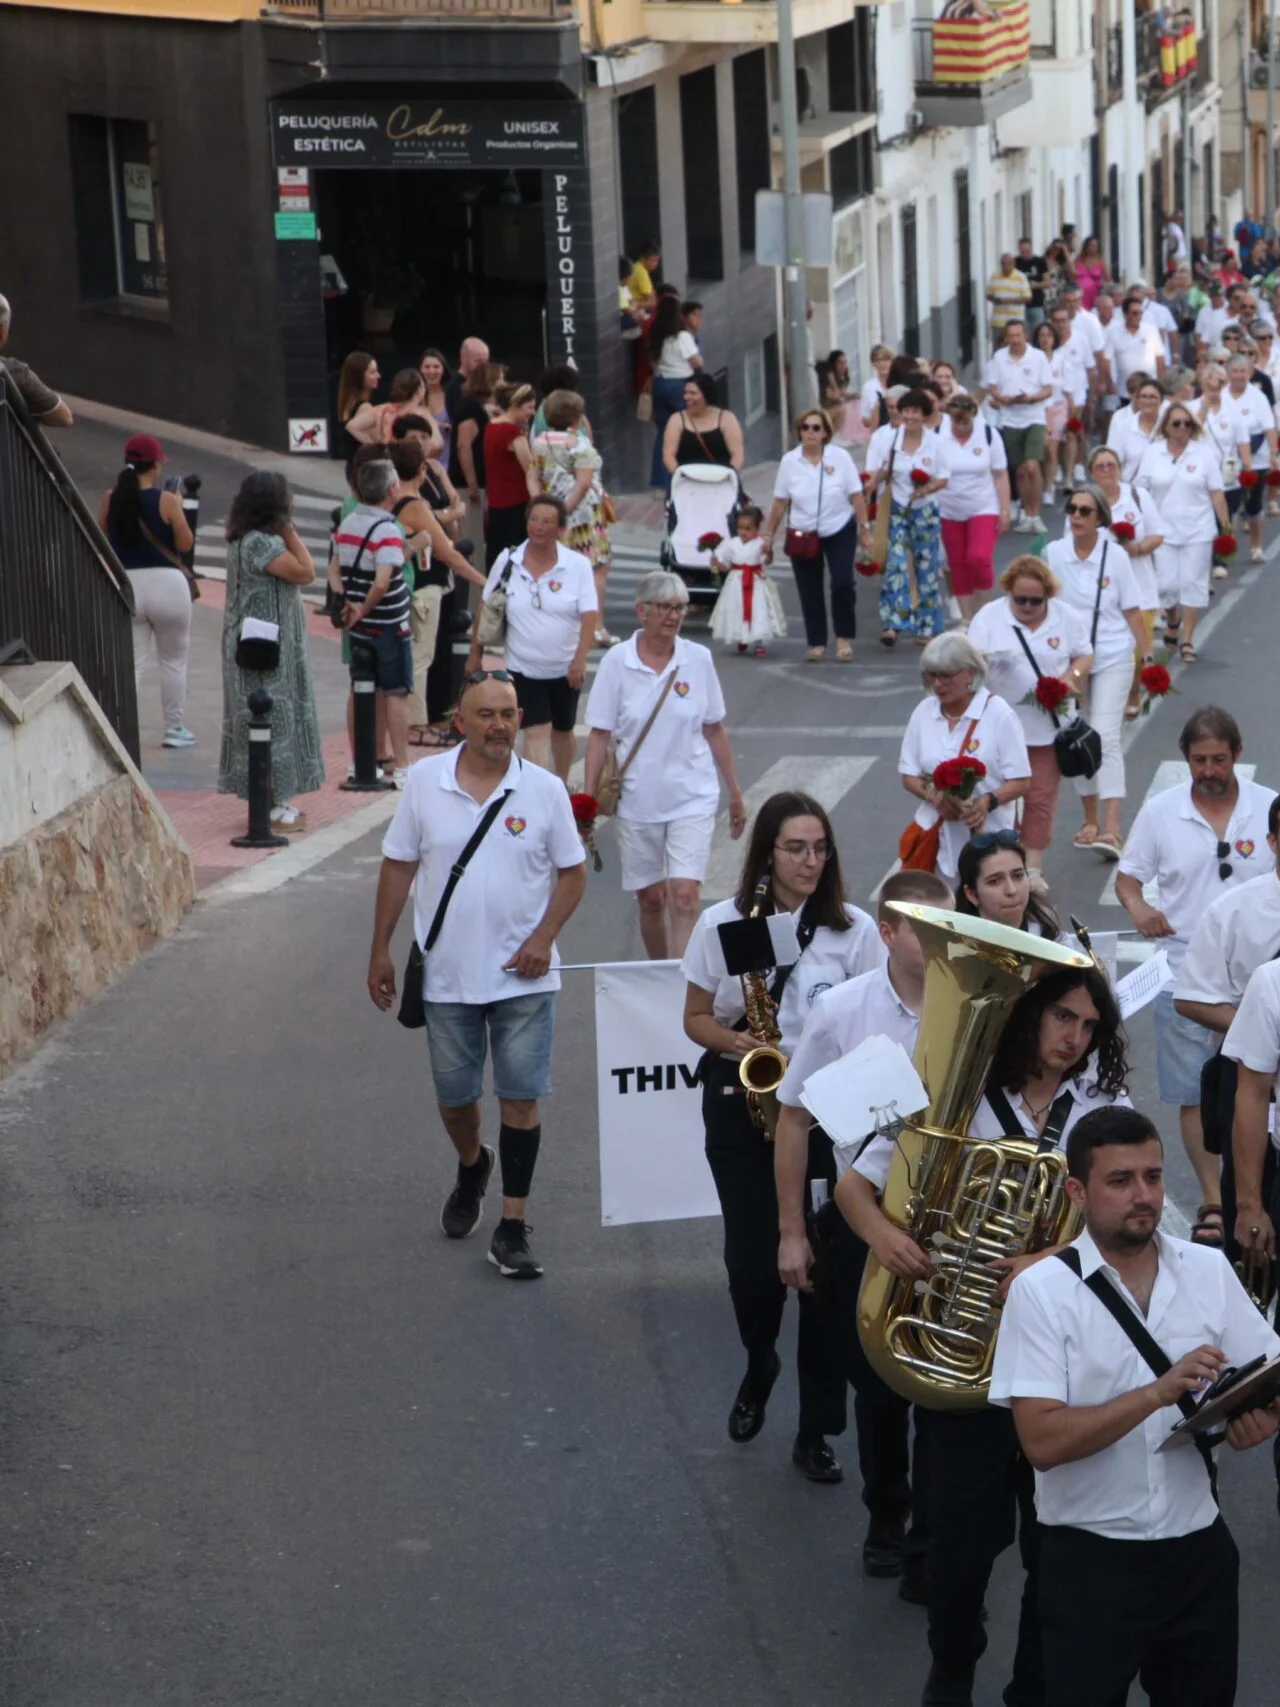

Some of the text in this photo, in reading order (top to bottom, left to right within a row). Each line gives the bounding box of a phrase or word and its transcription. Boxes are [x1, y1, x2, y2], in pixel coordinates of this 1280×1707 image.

[279, 113, 379, 131] PELUQUERÍA
[503, 121, 560, 134] UNISEX
[294, 136, 366, 152] ESTÉTICA
[485, 139, 531, 149] Productos
